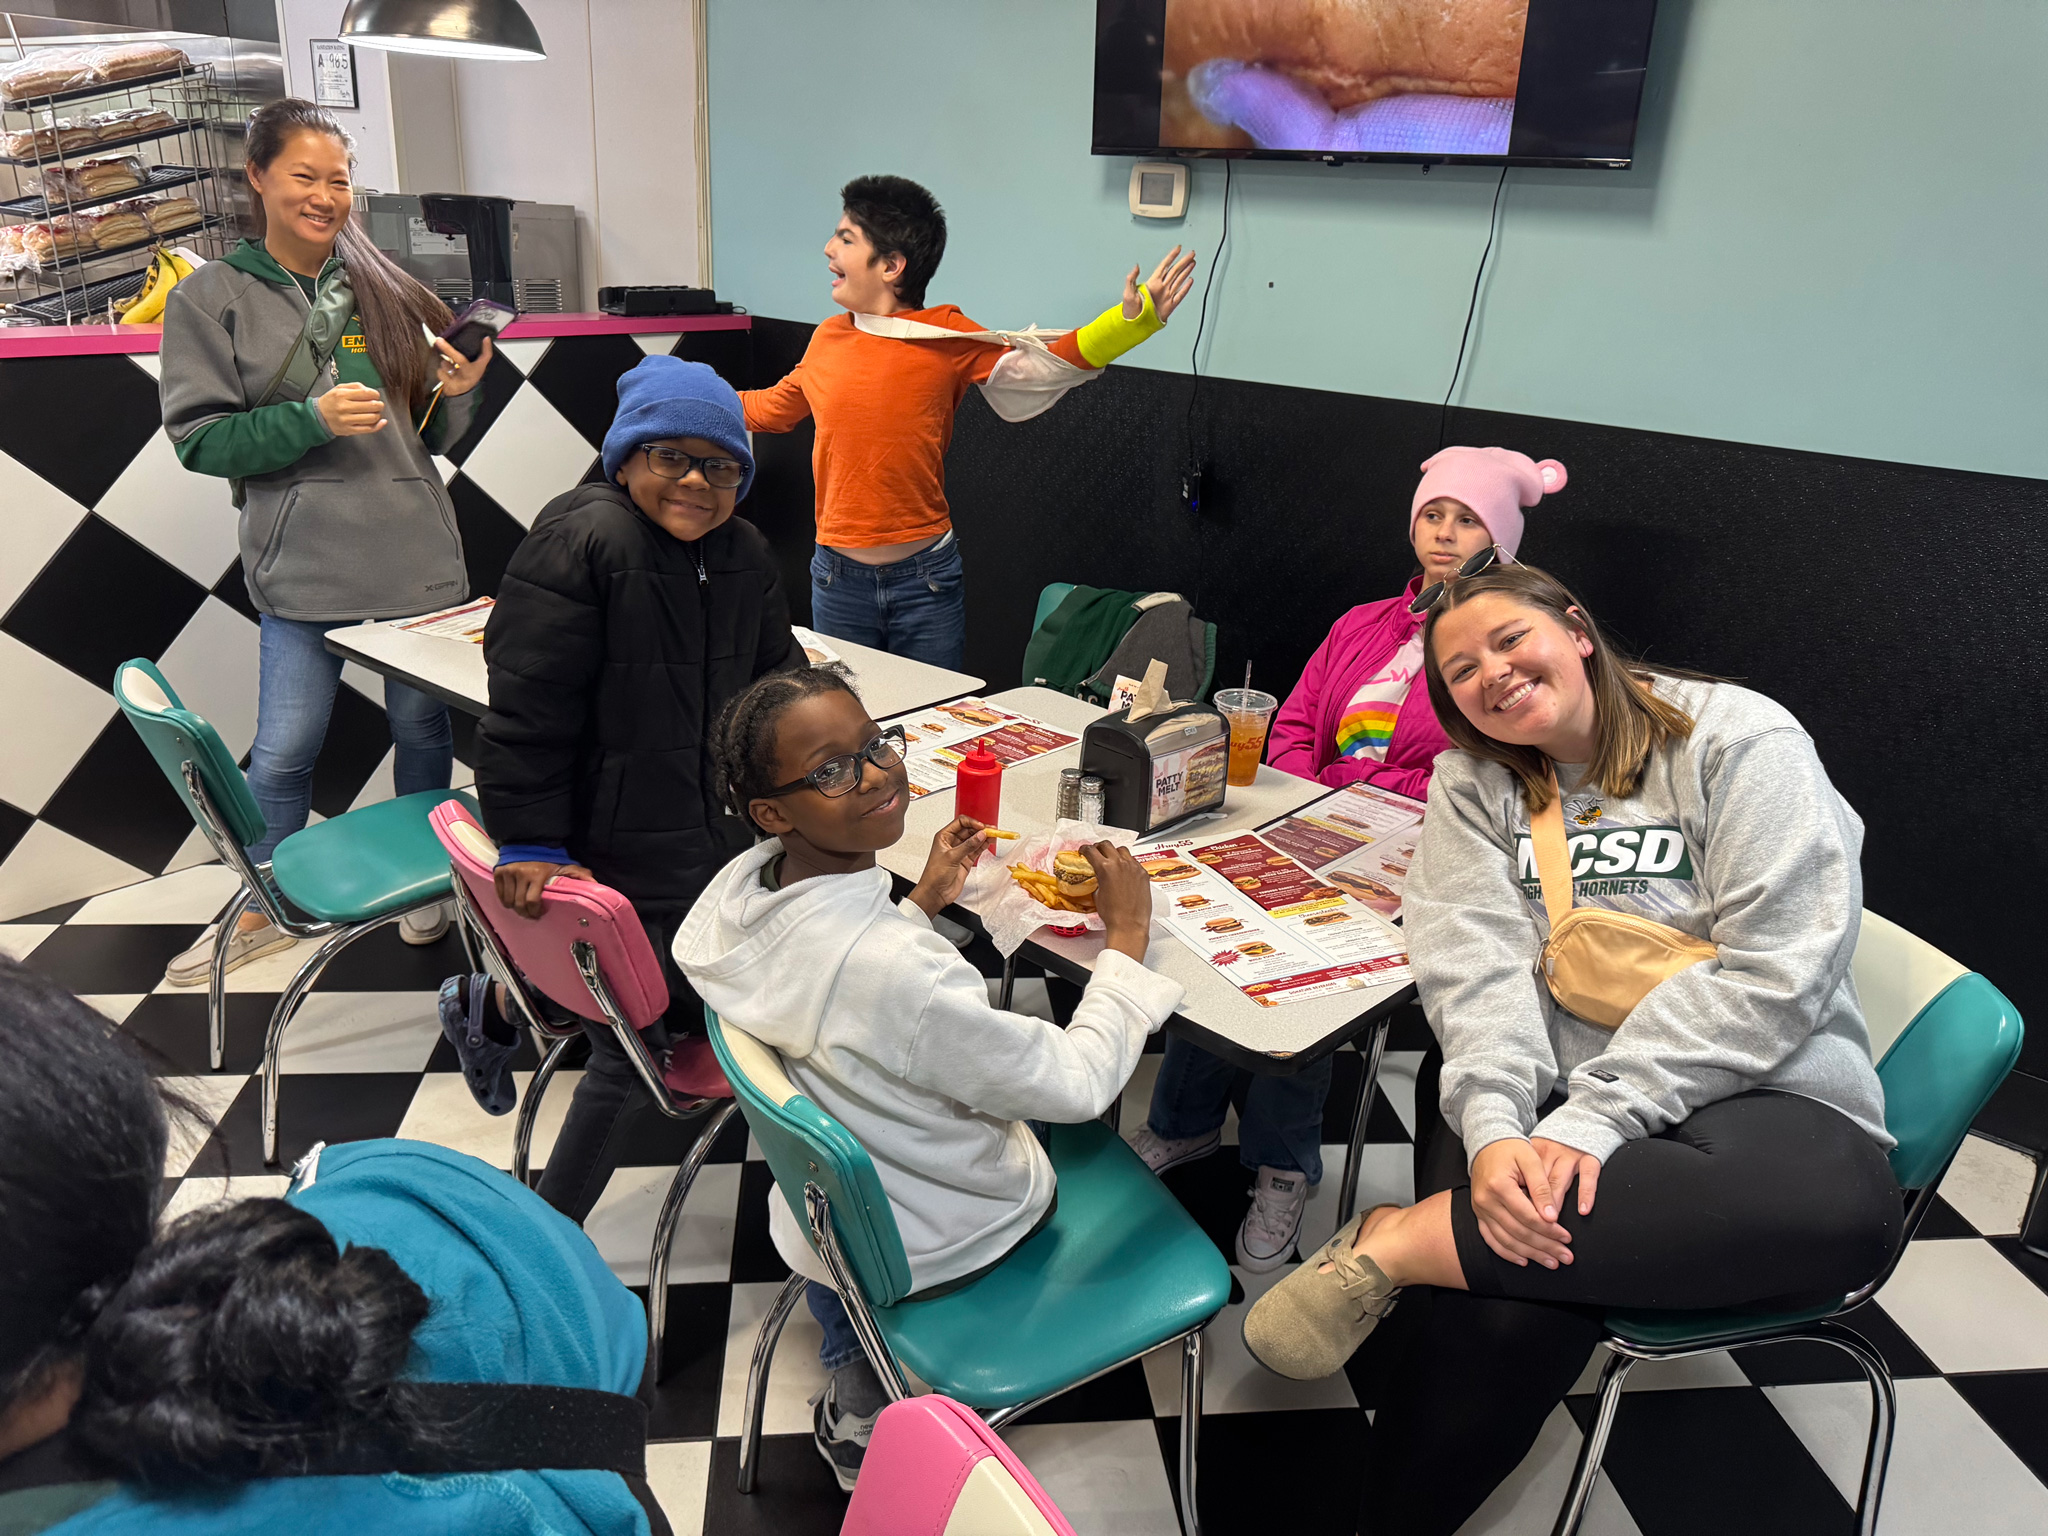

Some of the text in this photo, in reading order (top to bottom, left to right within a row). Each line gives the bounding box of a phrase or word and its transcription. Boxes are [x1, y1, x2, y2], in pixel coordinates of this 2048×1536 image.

[318, 54, 325, 68] A
[1230, 736, 1264, 751] wy55
[1156, 771, 1184, 788] PATTY
[1158, 781, 1181, 796] MELT
[1154, 839, 1194, 851] Hwy55
[1578, 880, 1649, 897] HORNETS
